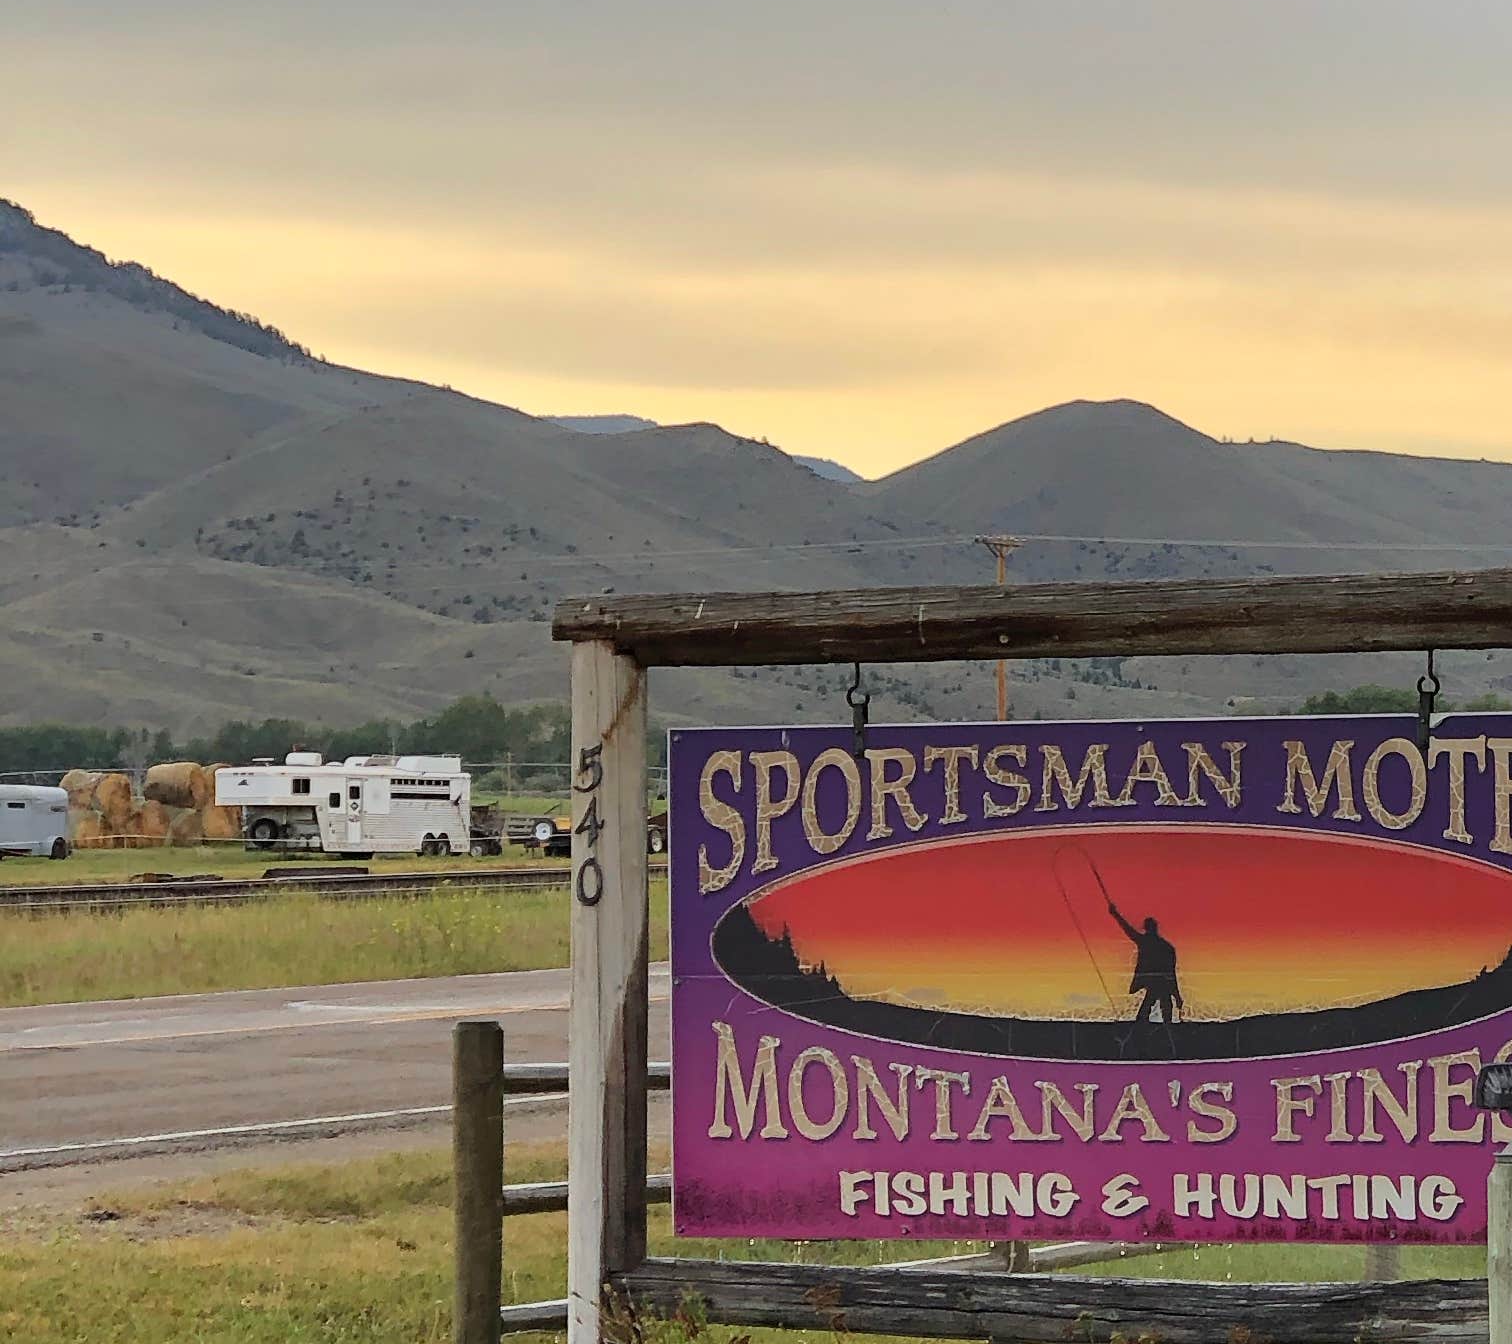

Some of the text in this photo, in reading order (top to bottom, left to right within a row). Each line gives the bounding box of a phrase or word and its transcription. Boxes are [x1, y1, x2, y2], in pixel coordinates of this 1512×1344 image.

[697, 740, 1246, 895] SPORTSMAN
[708, 1021, 1239, 1144] MONTANA'S
[839, 1170, 1464, 1222] FISHING & HUNTING
